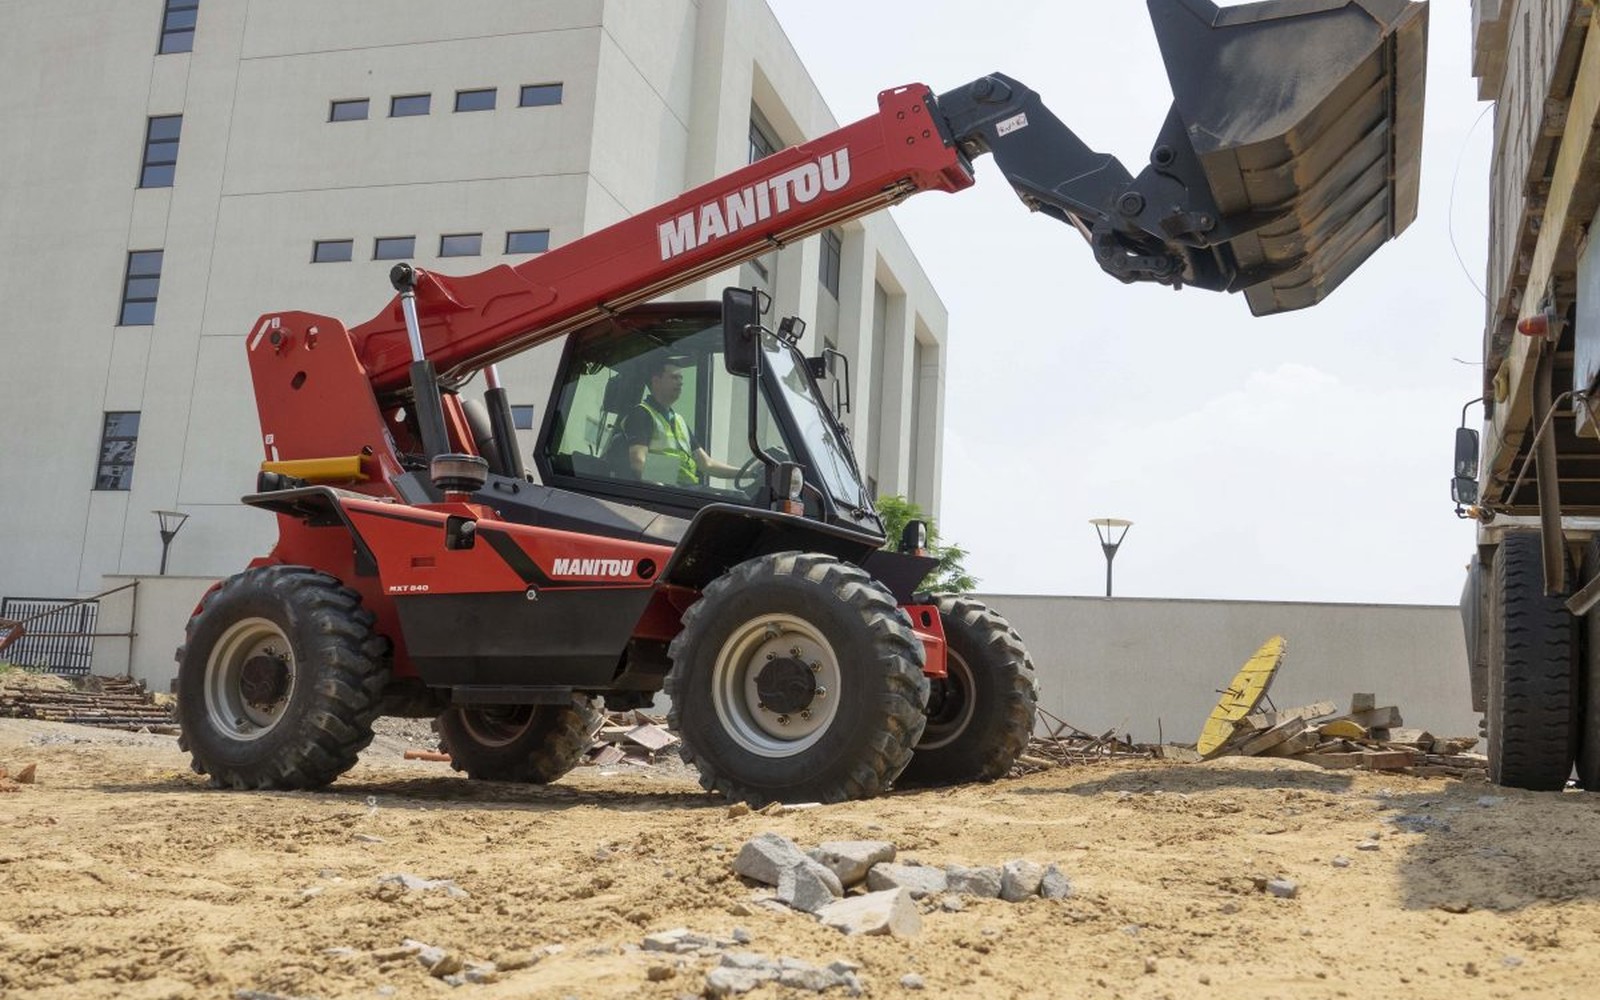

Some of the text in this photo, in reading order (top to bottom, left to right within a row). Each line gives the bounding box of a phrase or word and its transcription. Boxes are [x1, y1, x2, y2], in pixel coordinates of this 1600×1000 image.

[658, 147, 851, 261] MANITOU
[552, 558, 634, 577] MANITOU
[410, 584, 429, 592] 840
